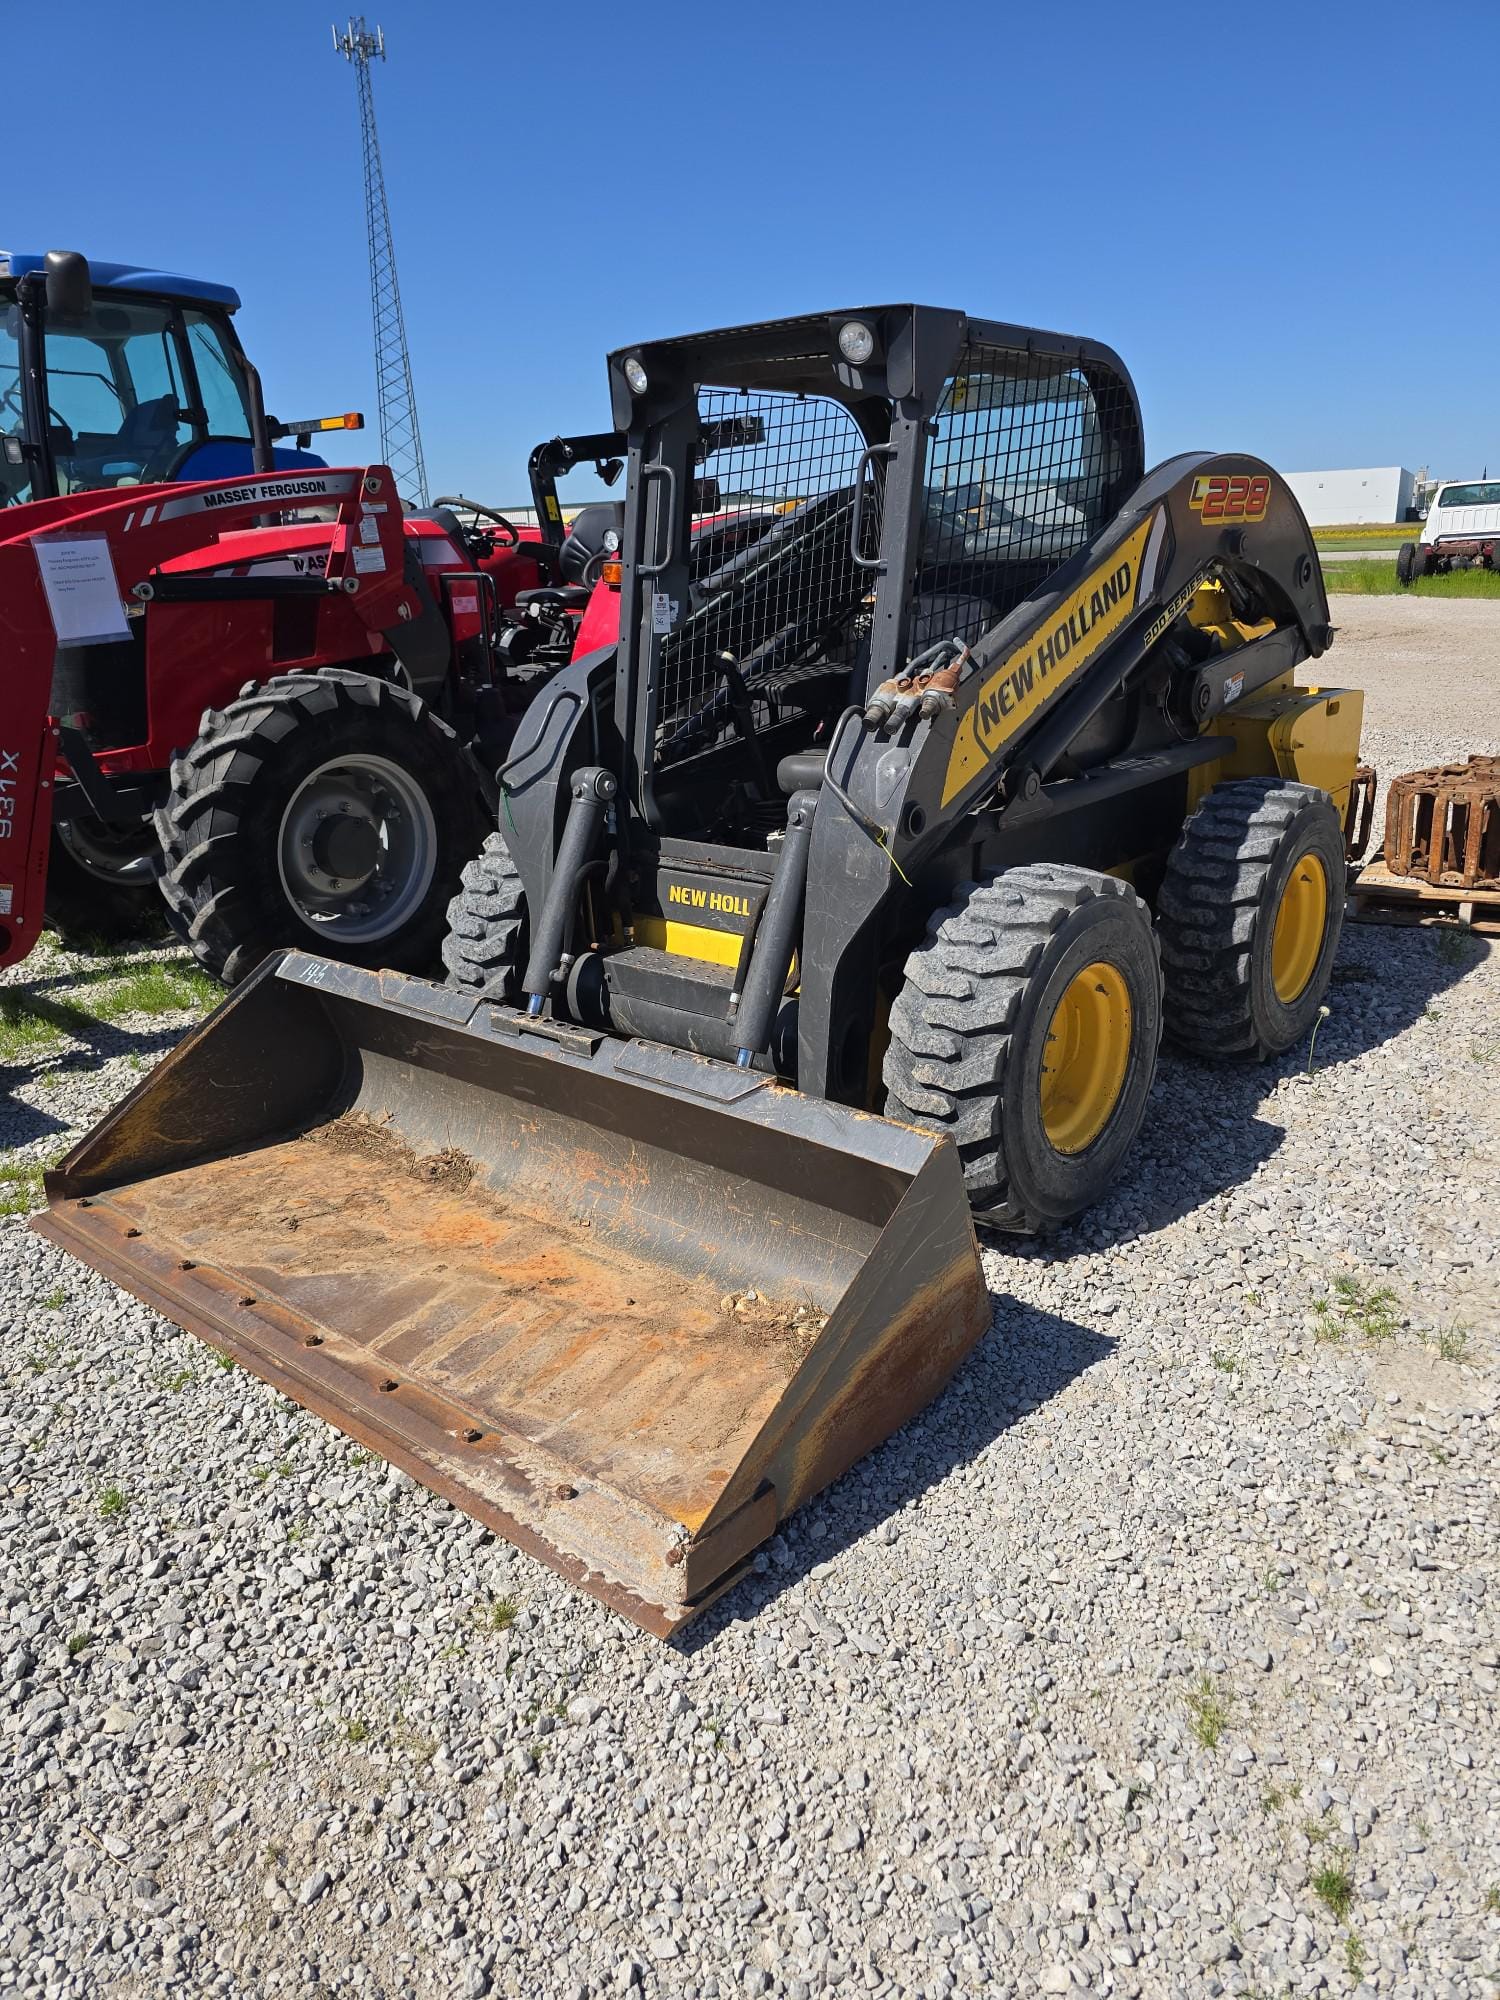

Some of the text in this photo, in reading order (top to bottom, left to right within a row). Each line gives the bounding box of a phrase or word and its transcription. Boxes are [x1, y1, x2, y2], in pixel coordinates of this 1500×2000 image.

[203, 481, 327, 508] MASSEY FERGUSON
[1189, 476, 1271, 526] L228
[1144, 570, 1204, 646] 200 SERIES
[979, 561, 1131, 737] NEW HOLLAND
[669, 885, 750, 917] NEW HOLL
